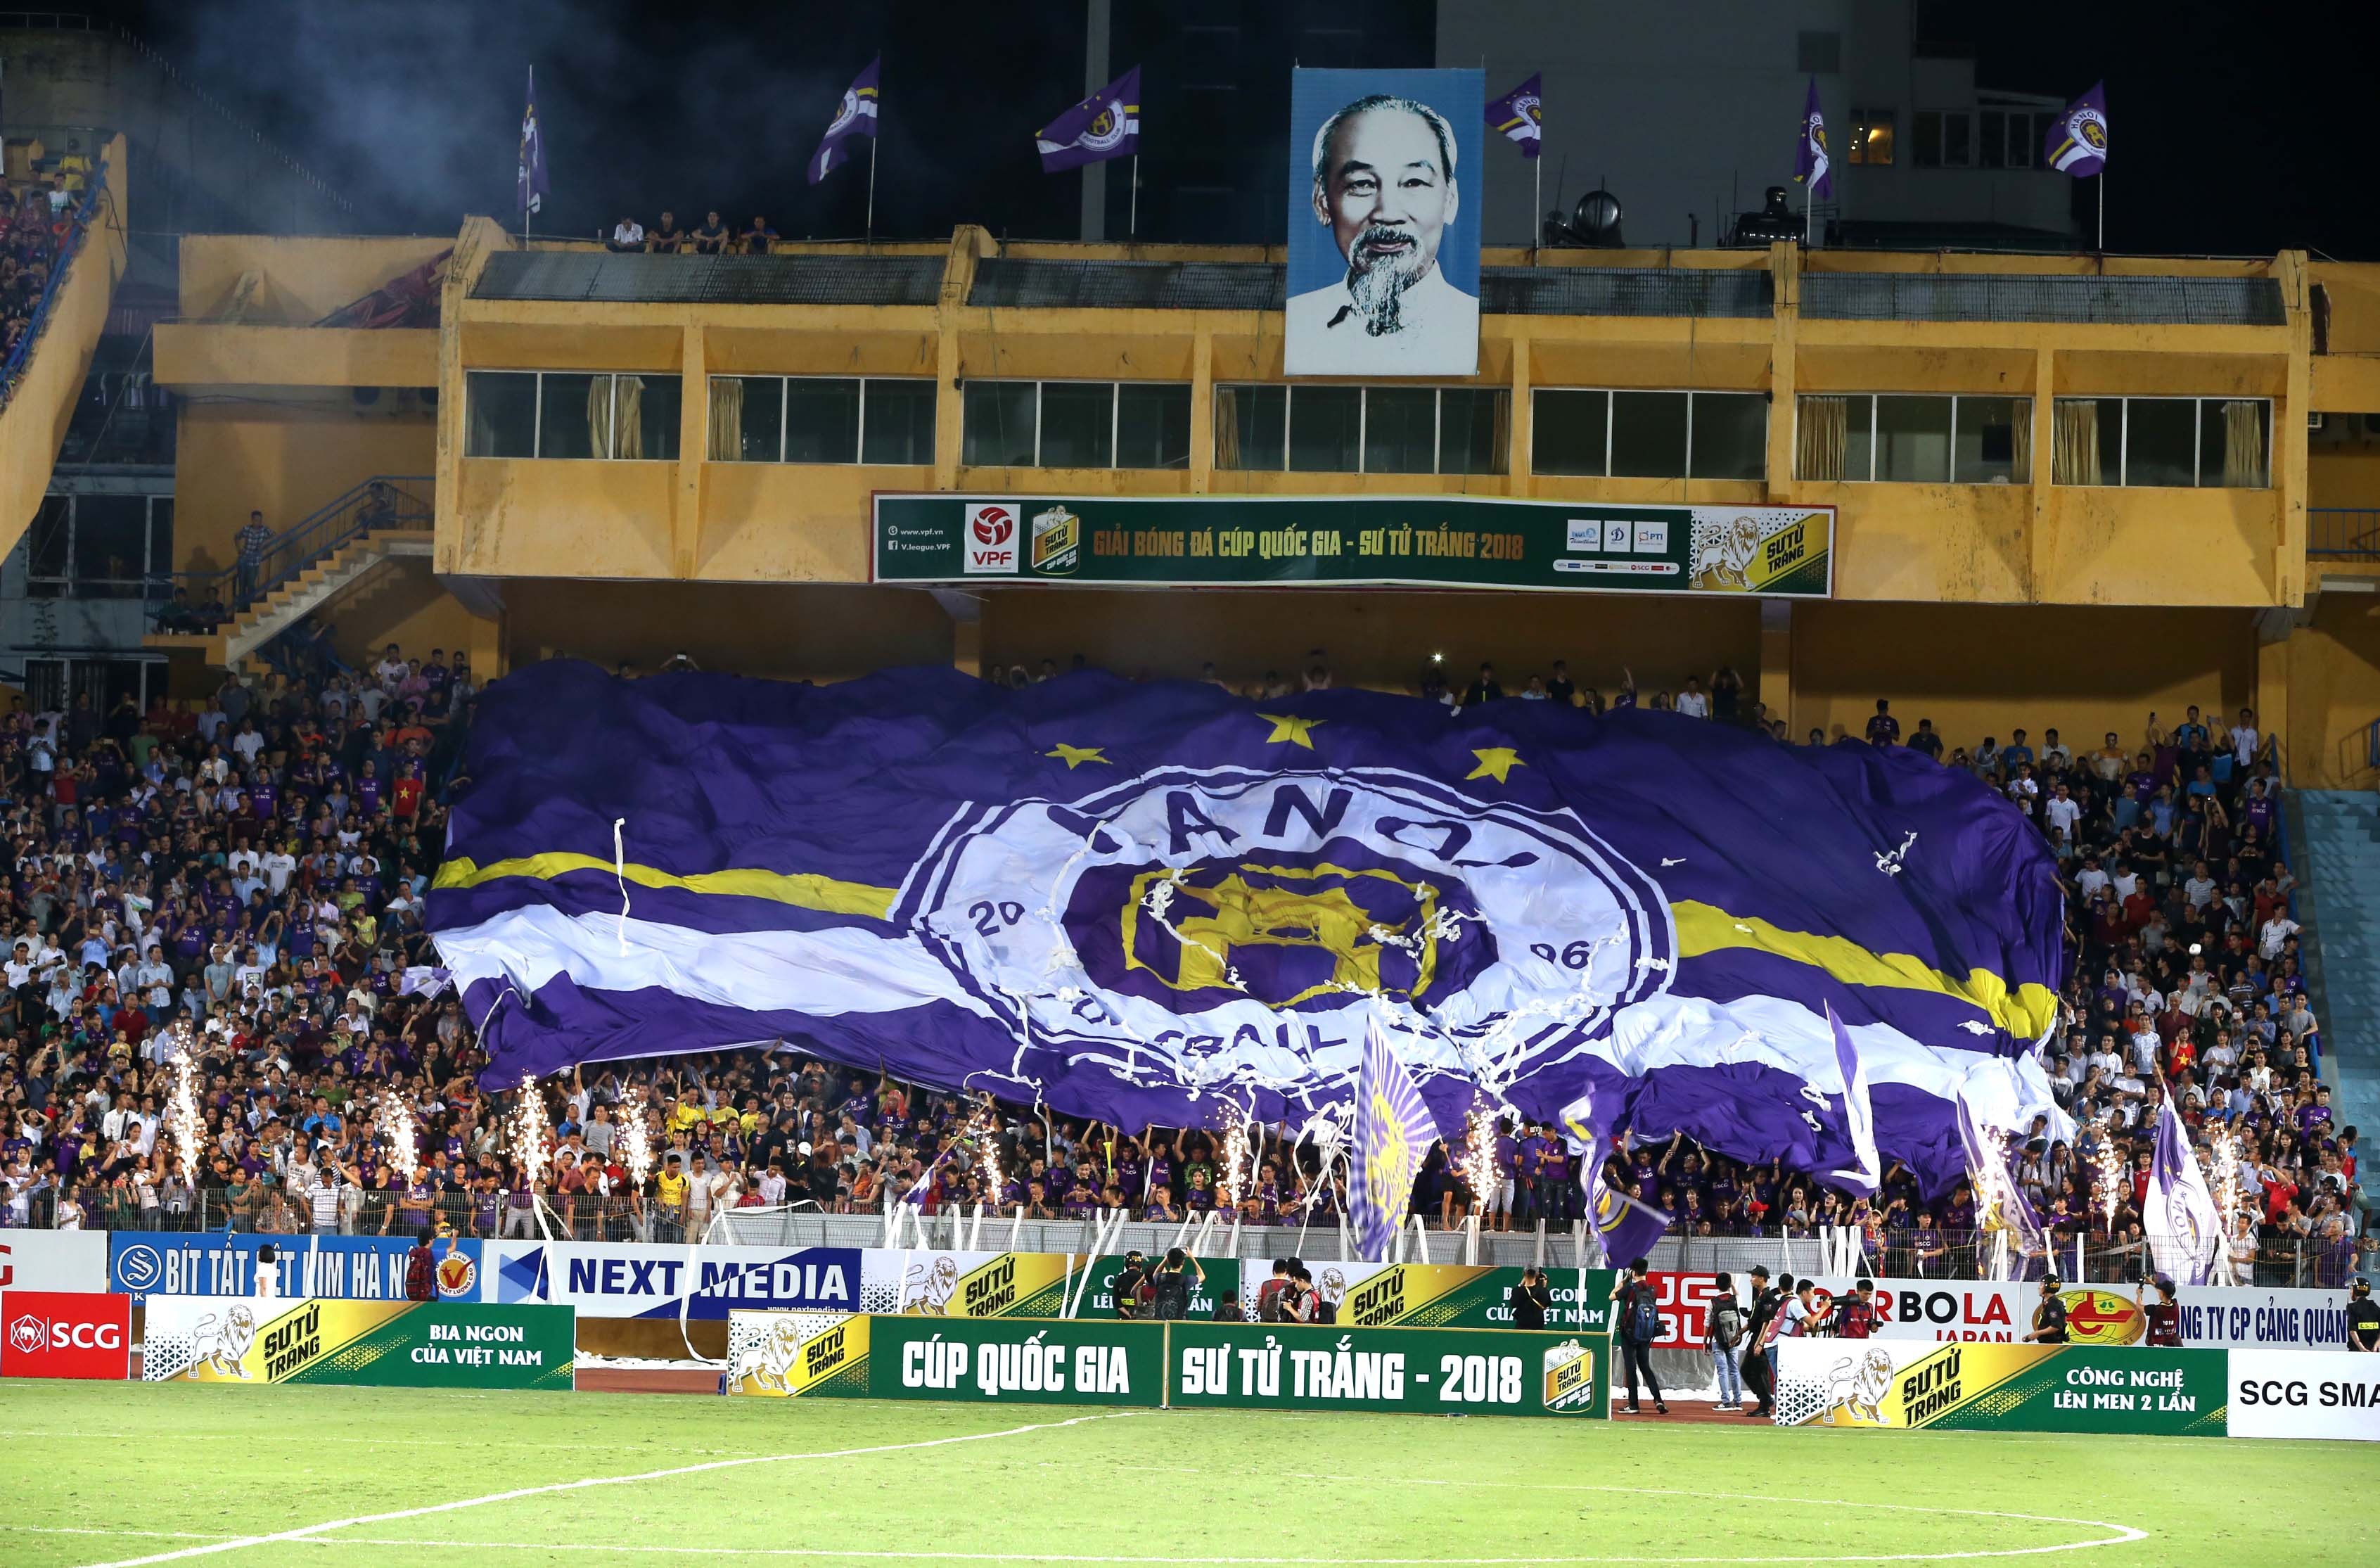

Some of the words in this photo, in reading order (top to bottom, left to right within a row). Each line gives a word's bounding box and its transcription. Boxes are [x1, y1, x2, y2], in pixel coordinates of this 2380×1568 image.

[1518, 98, 1538, 113] HANO
[2071, 111, 2098, 129] HANOI
[901, 528, 944, 537] www.vpf.vn
[1094, 522, 1128, 556] GIẢI
[1134, 525, 1184, 557] BÓNG
[1190, 525, 1214, 557] ĐÁ
[1218, 523, 1254, 558] CÚP
[1259, 523, 1306, 560] QUỐC
[1312, 530, 1341, 557] GIA
[1359, 530, 1386, 556] SƯ
[1390, 523, 1413, 556] TỬ
[1416, 523, 1475, 559] TRẮNG
[1480, 533, 1524, 561] 2018
[973, 552, 1012, 565] VPF
[967, 901, 1025, 937] 20
[1529, 938, 1591, 970] 06
[165, 1242, 202, 1294] BÍT
[208, 1235, 249, 1296] TẤT
[352, 1245, 380, 1299] HÀ
[568, 1258, 684, 1296] NEXT
[700, 1262, 849, 1301] MEDIA
[1093, 1293, 1114, 1308] LÊ
[1565, 1309, 1604, 1323] NAM
[2207, 1306, 2225, 1341] TY
[2230, 1307, 2251, 1342] CP
[2256, 1296, 2300, 1343] CẢNG
[2304, 1297, 2347, 1346] QUẢN
[52, 1322, 120, 1349] SCG
[429, 1325, 463, 1341] BIA
[470, 1326, 524, 1342] NGON
[411, 1341, 448, 1364] CỦA
[454, 1346, 493, 1368] VIỆT
[499, 1350, 542, 1366] NAM
[902, 1332, 968, 1389] CÚP
[977, 1330, 1066, 1396] QUỐC
[1074, 1345, 1130, 1394] GIA
[1182, 1342, 1231, 1396] SƯ
[1238, 1335, 1283, 1396] TỬ
[1290, 1334, 1405, 1400] TRẮNG
[1439, 1354, 1523, 1403] 2018
[2066, 1366, 2125, 1387] CÔNG
[2130, 1369, 2185, 1389] NGHỆ
[1578, 1392, 1591, 1406] 2018
[2053, 1389, 2090, 1410] LÊN
[2093, 1393, 2135, 1410] MEN
[2139, 1395, 2152, 1410] 2
[2158, 1387, 2196, 1413] LẦN
[2239, 1380, 2308, 1406] SCG
